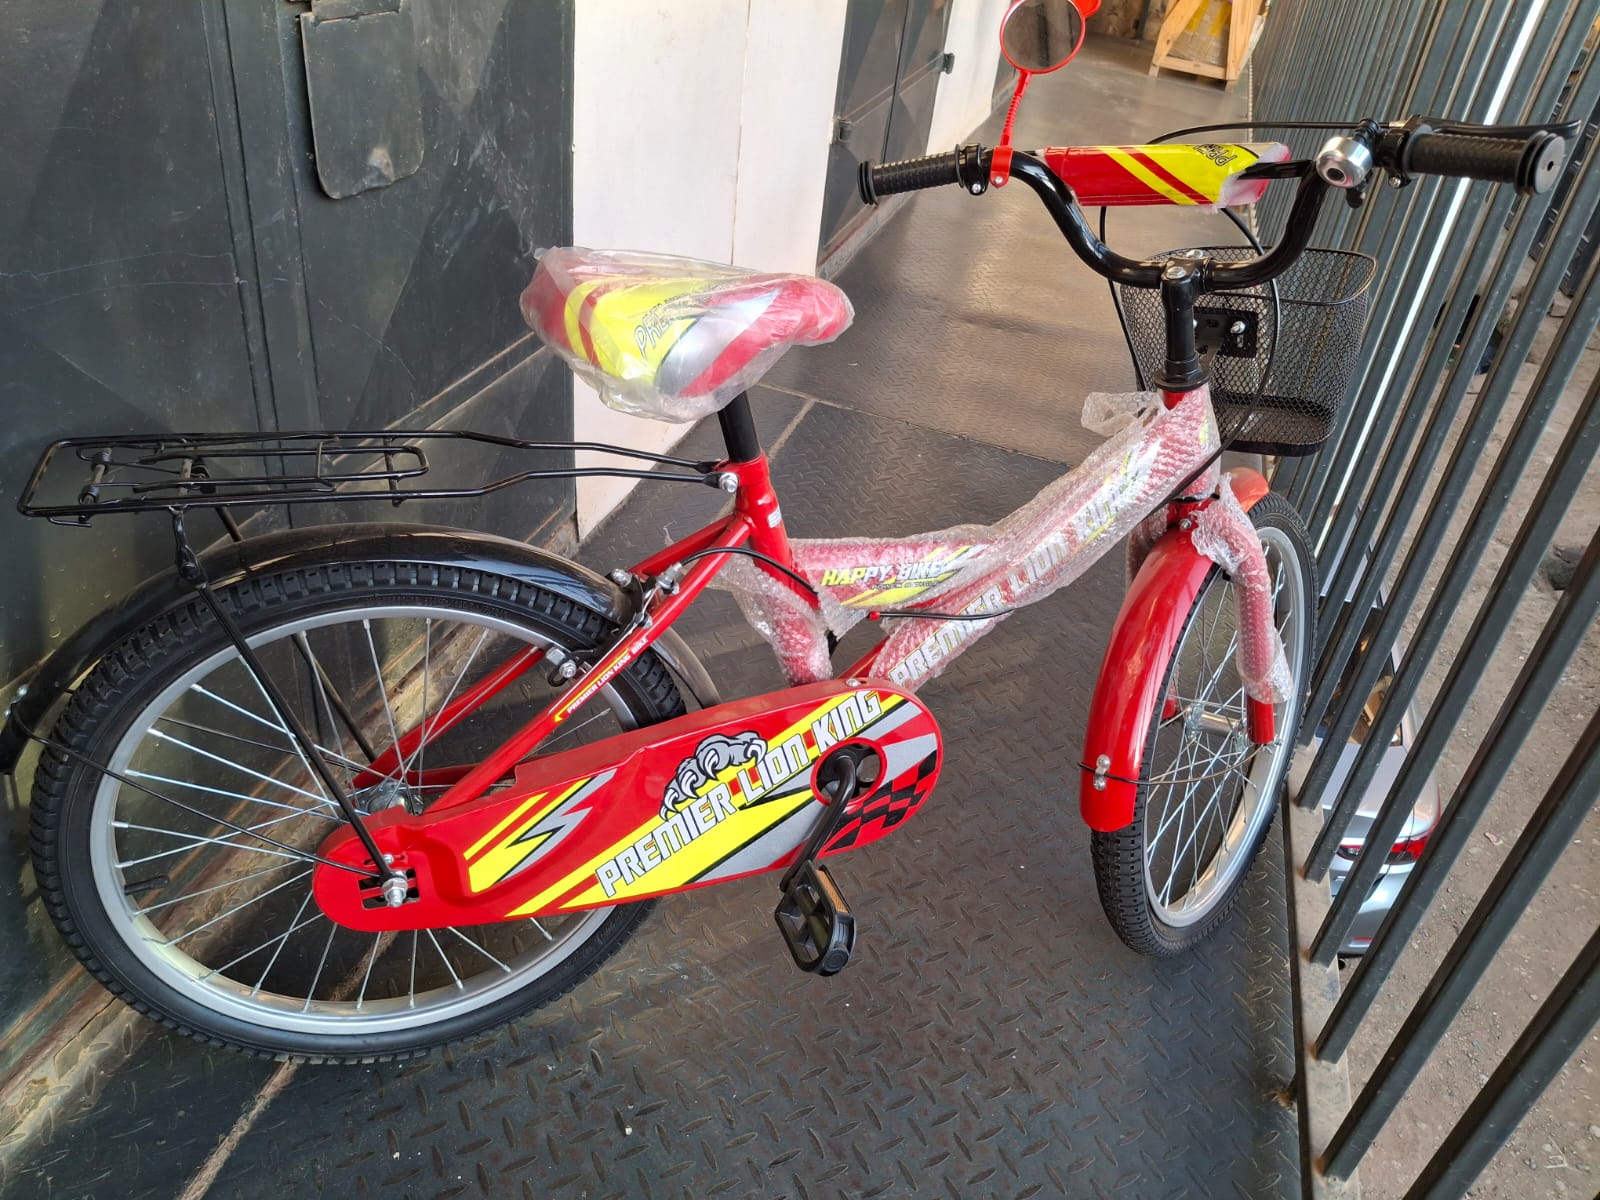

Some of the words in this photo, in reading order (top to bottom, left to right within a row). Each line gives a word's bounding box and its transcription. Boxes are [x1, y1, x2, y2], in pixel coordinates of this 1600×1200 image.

[821, 565, 895, 587] HAPPY
[1008, 531, 1070, 595] LION
[566, 684, 598, 714] PREMIER
[597, 669, 614, 686] LION
[613, 654, 632, 672] KING
[631, 638, 649, 654] BIKE
[595, 784, 737, 898] PREMIER
[736, 733, 810, 803] LION
[811, 690, 883, 754] KING
